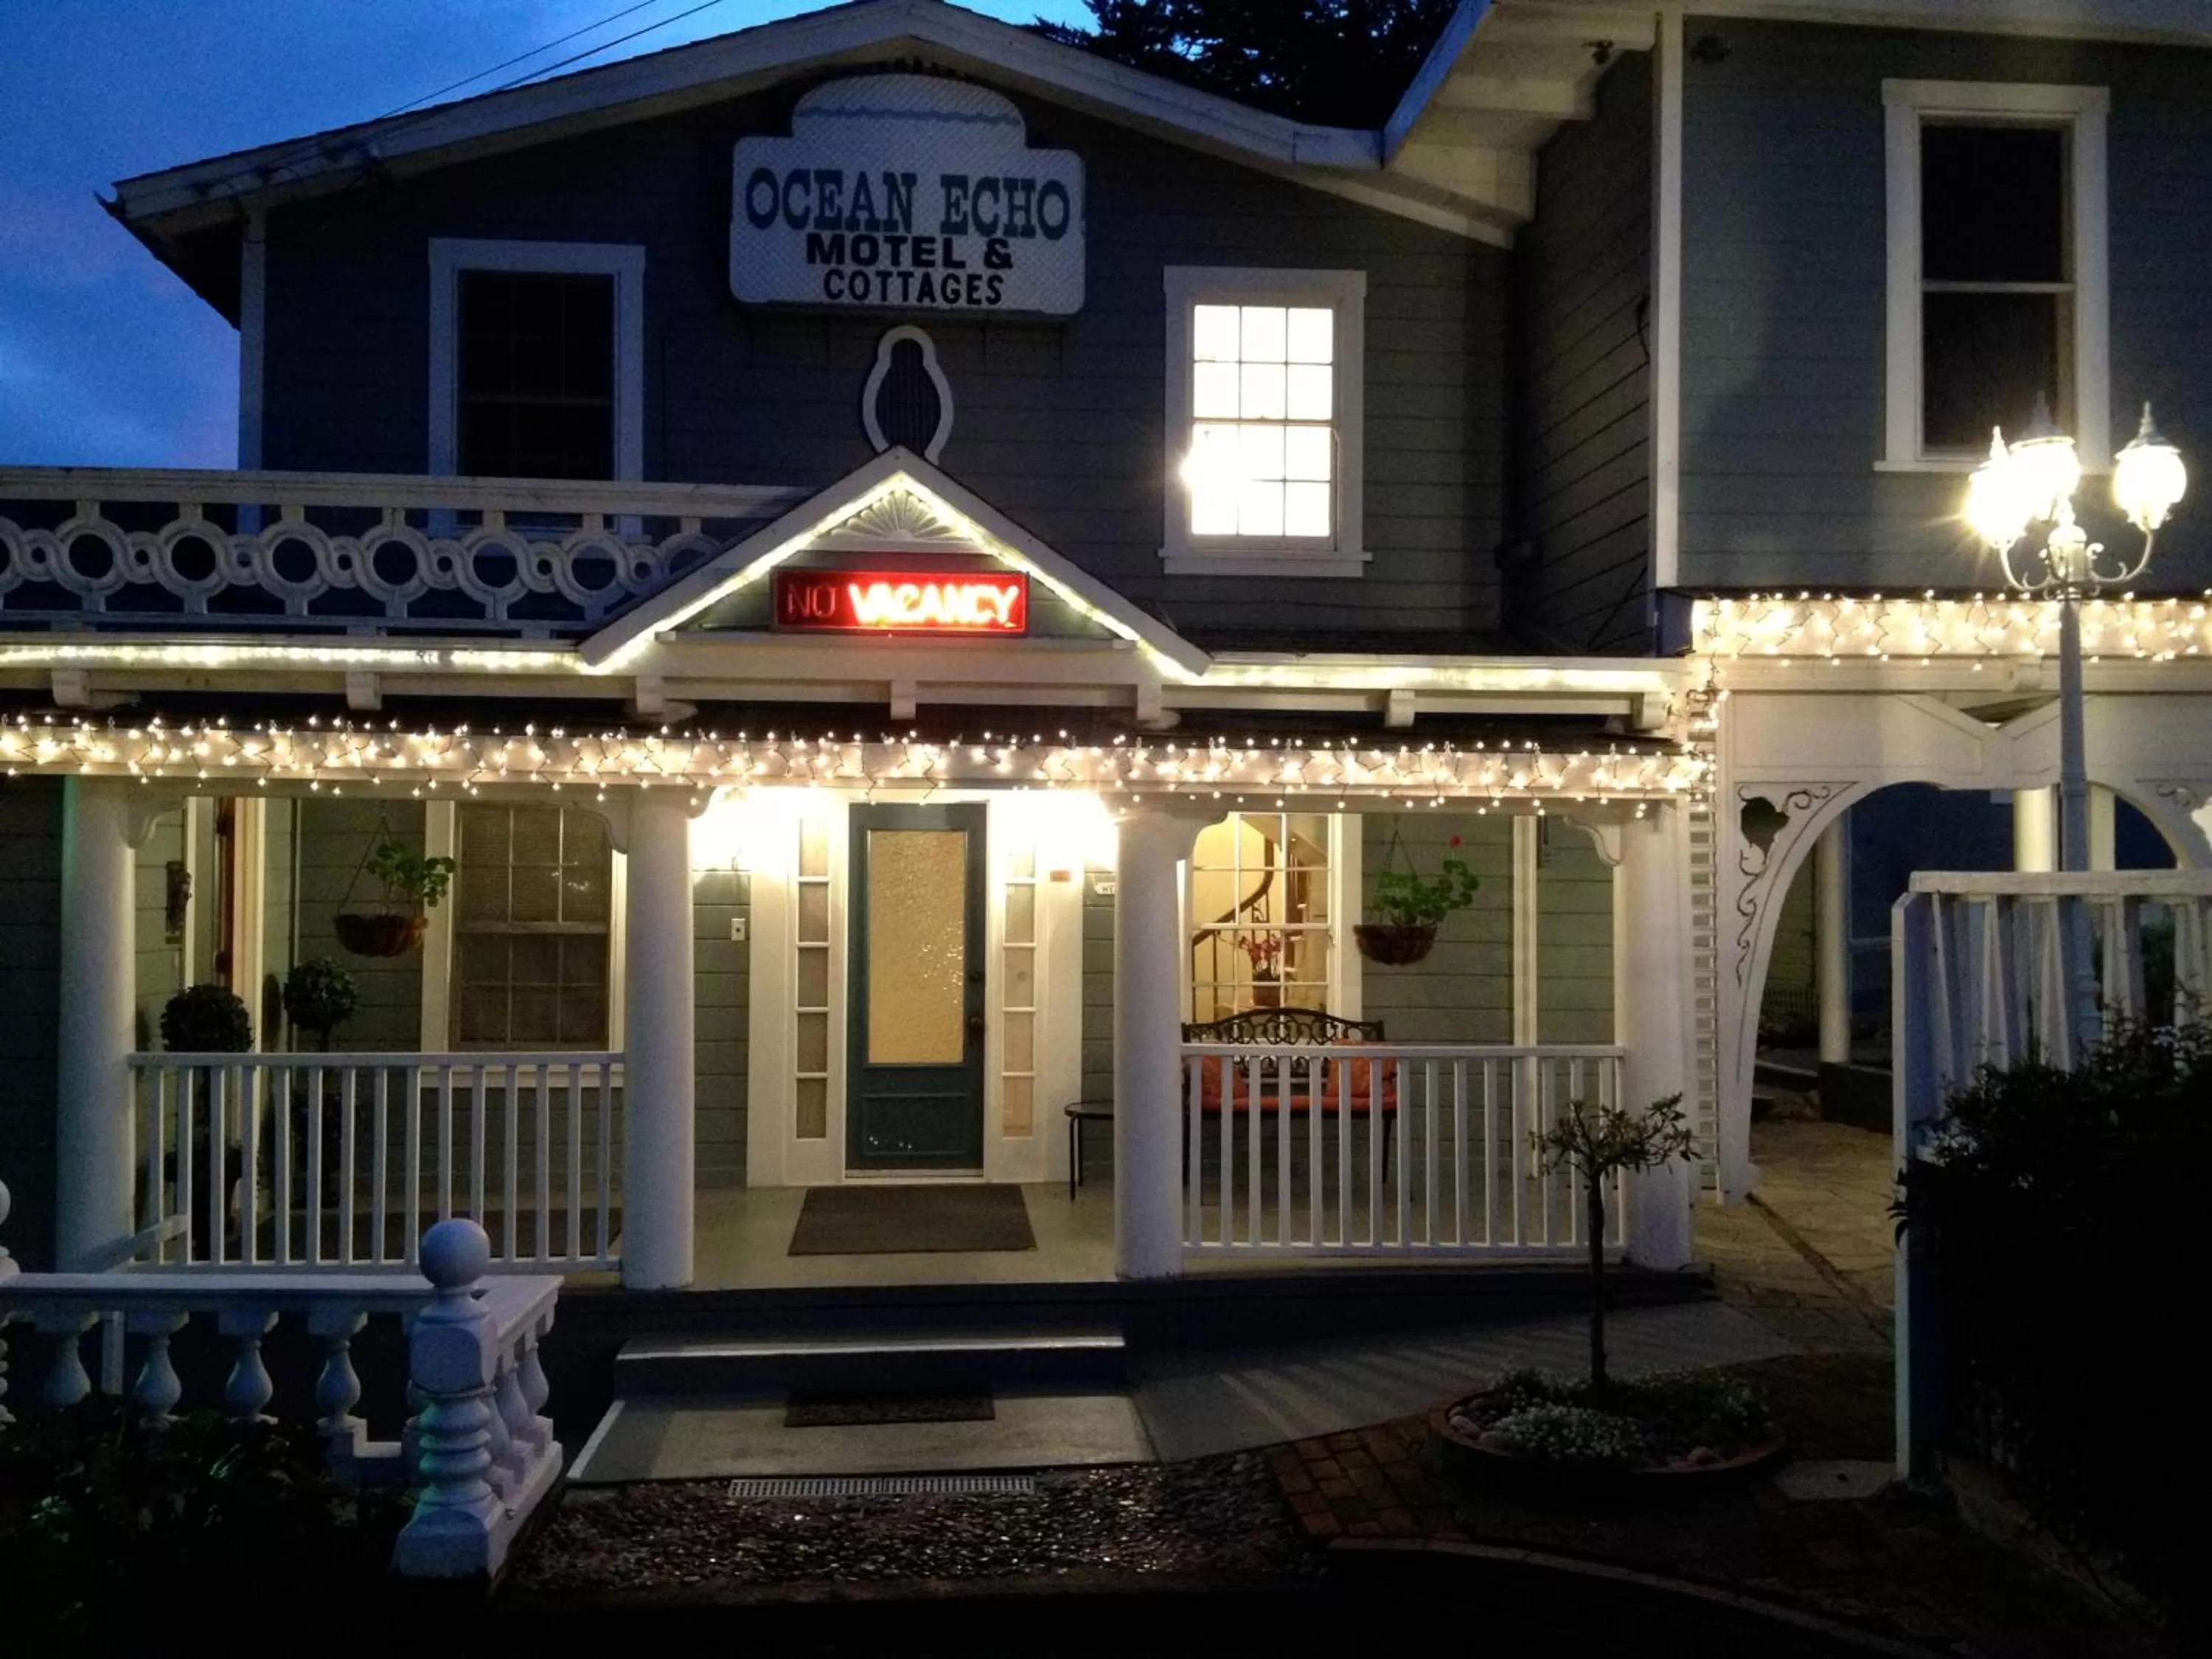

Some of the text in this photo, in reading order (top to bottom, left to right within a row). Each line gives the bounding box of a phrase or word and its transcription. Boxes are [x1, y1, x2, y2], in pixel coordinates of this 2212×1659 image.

[746, 168, 1070, 240] OCEAN ECHO
[807, 233, 1013, 269] MOTEL &
[824, 269, 1004, 305] COTTAGES
[787, 582, 1020, 625] NO VACANCY
